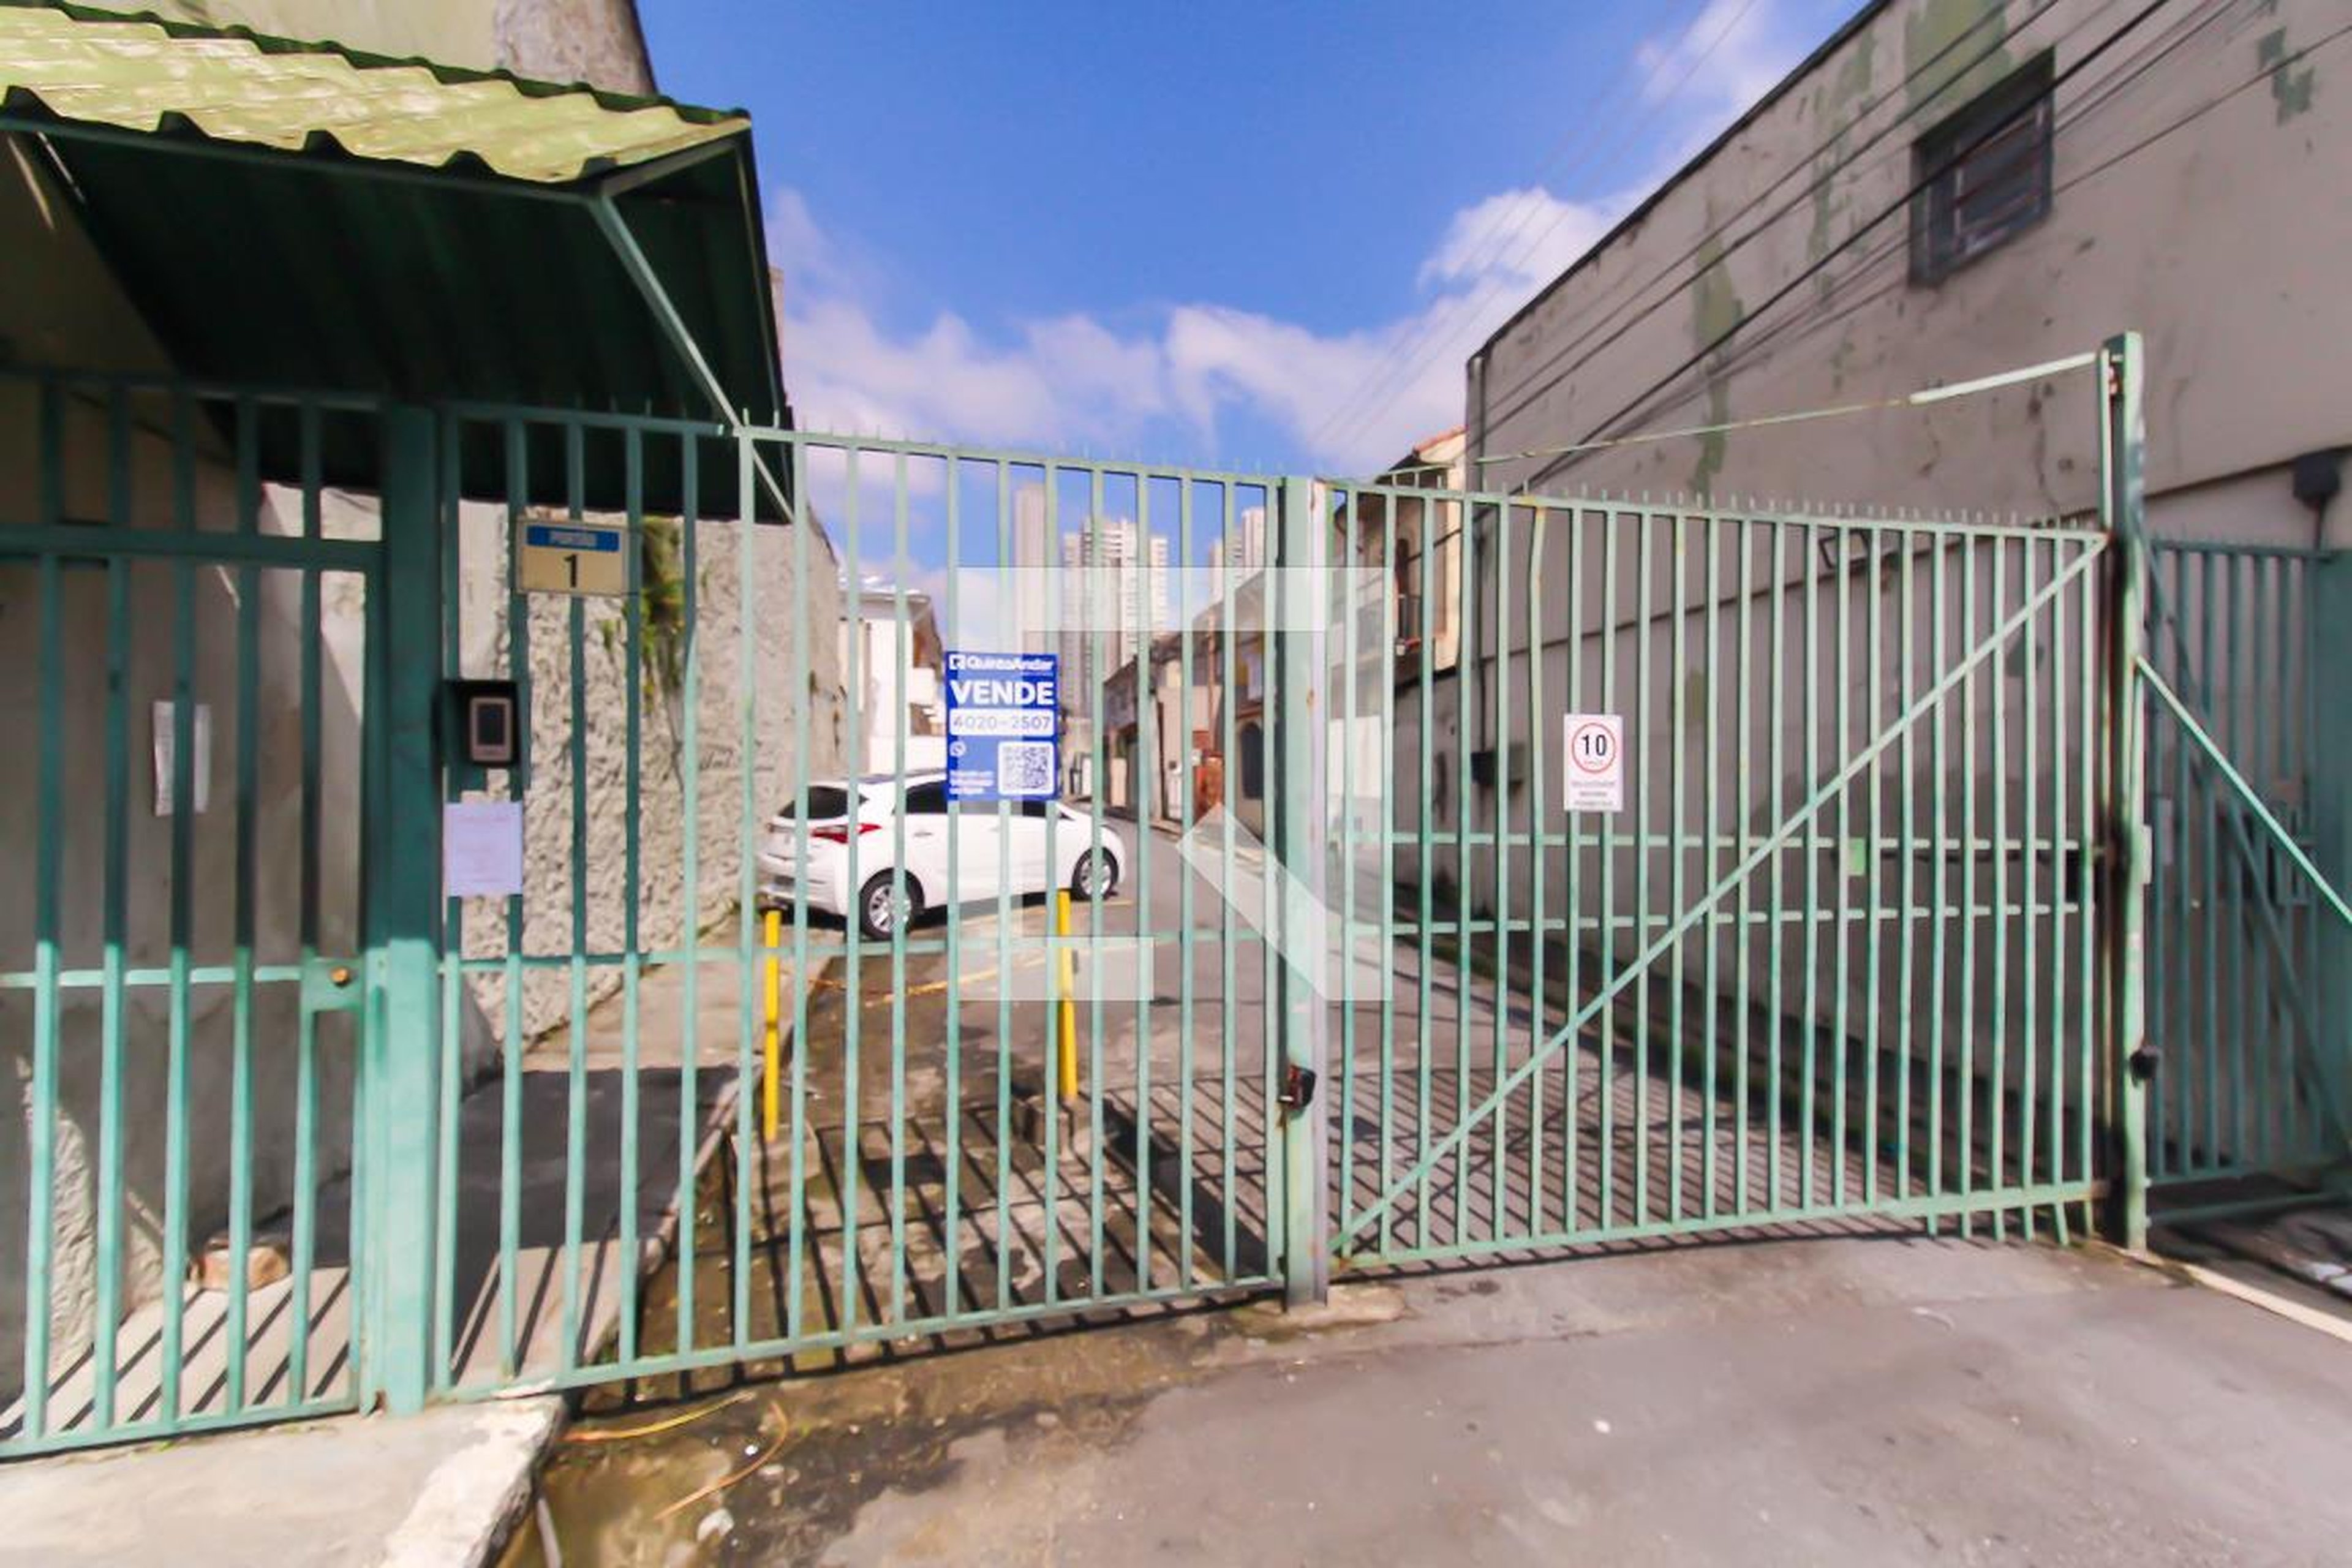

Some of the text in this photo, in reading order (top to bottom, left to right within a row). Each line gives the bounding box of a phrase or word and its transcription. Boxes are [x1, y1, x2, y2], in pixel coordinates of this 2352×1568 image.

[564, 554, 578, 587] 1
[950, 680, 1054, 705] VENDE
[1582, 734, 1607, 756] 10
